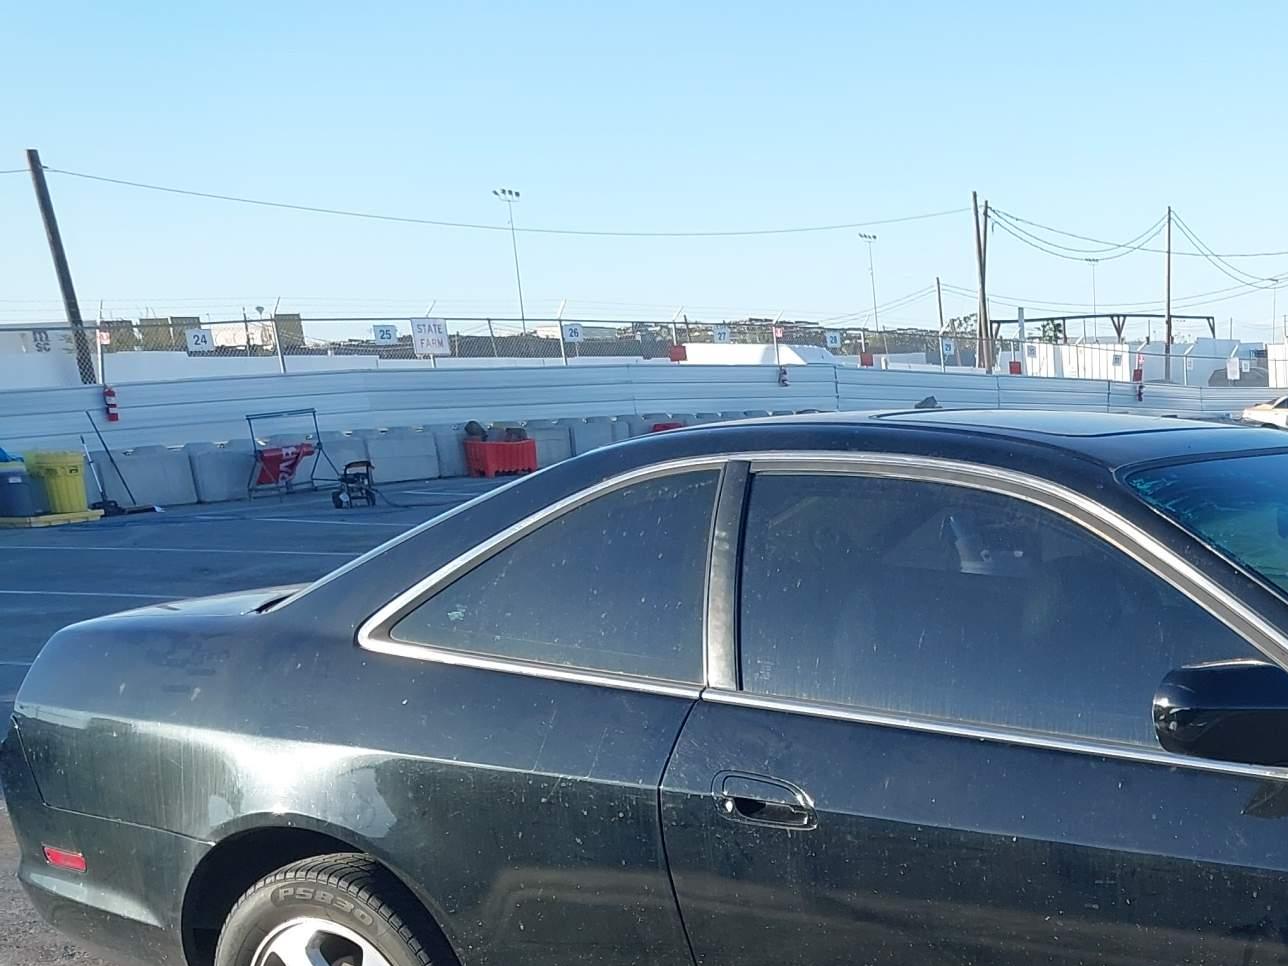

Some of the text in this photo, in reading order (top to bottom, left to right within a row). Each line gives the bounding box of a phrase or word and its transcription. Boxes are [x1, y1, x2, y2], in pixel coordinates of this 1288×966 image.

[417, 324, 443, 334] STATE
[568, 328, 579, 337] 26
[193, 334, 208, 345] 24
[379, 330, 391, 339] 25
[717, 331, 726, 341] 27
[420, 338, 444, 348] FARM
